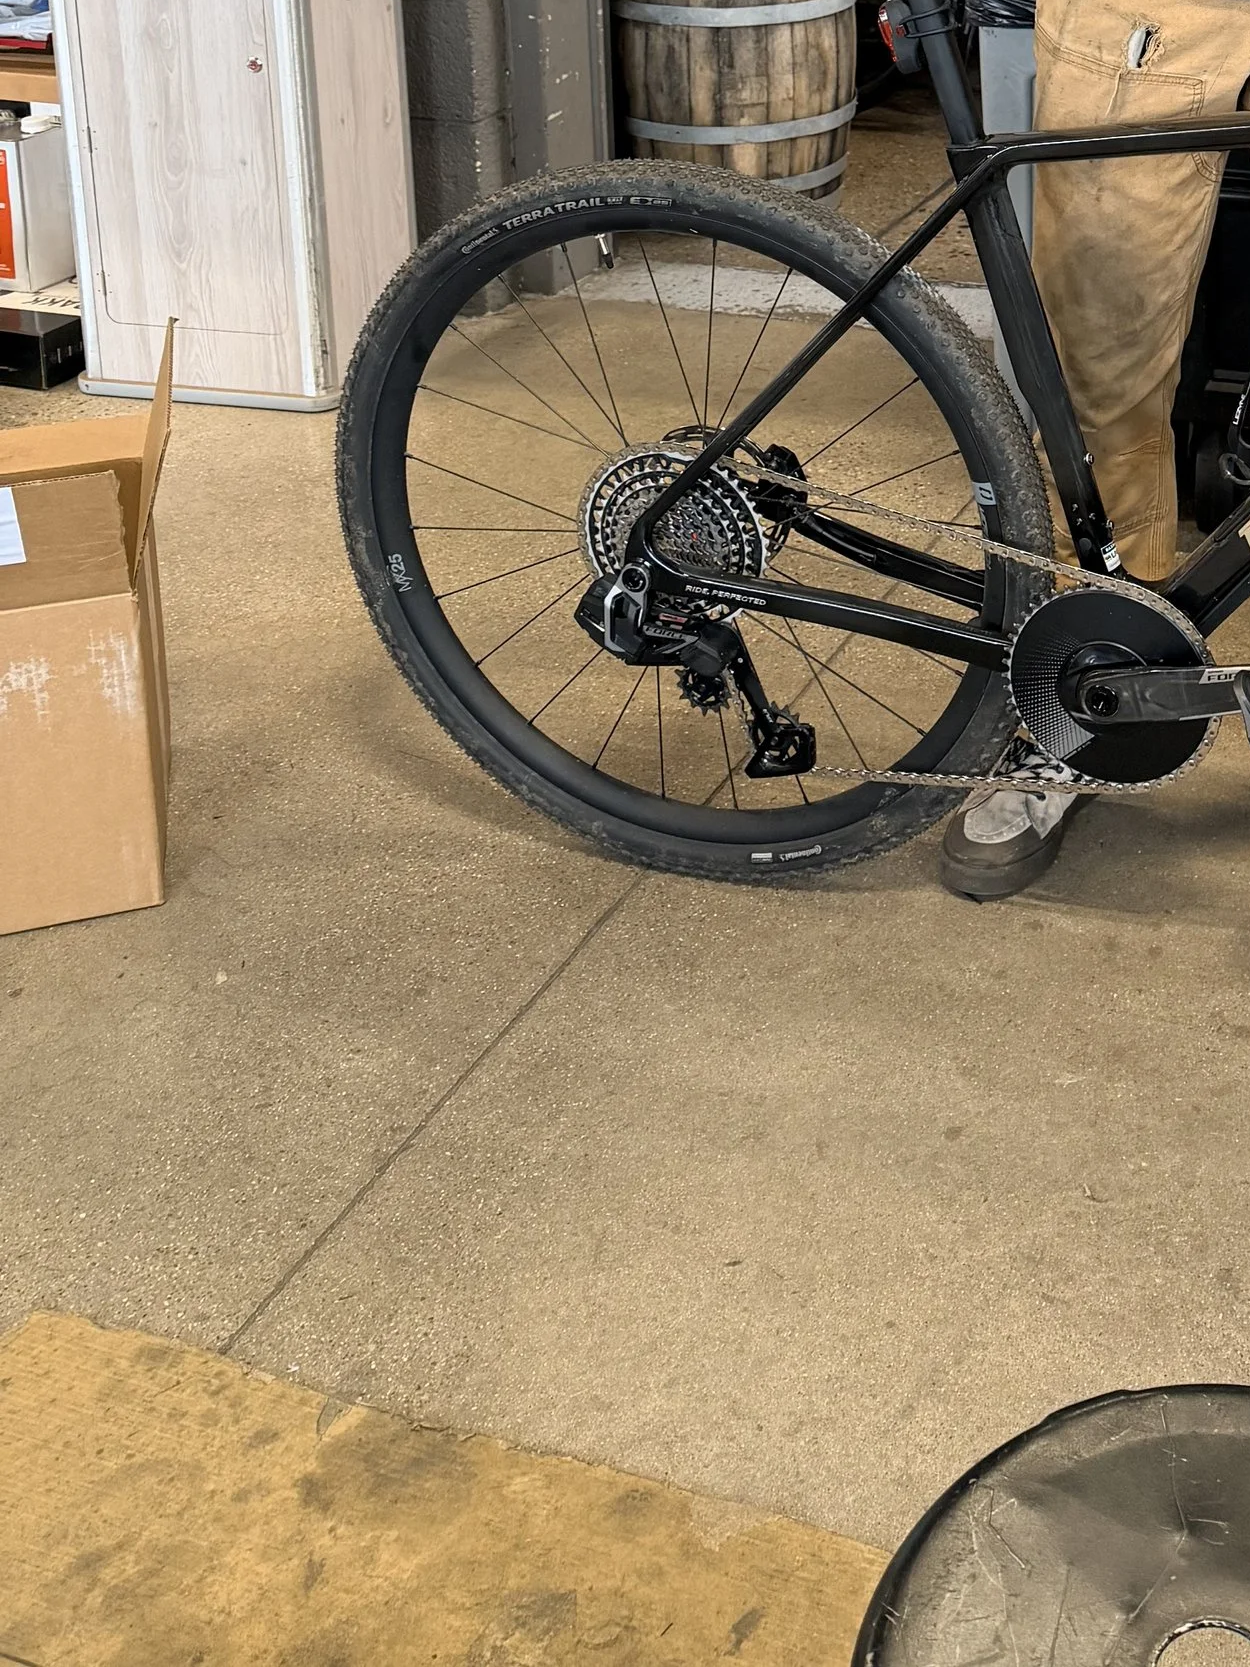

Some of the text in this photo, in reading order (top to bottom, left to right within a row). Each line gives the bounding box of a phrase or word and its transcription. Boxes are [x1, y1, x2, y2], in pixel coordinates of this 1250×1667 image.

[461, 229, 496, 254] Continental
[502, 207, 556, 230] TERRA
[554, 196, 605, 213] TRAIL
[711, 589, 767, 606] PERFECTED
